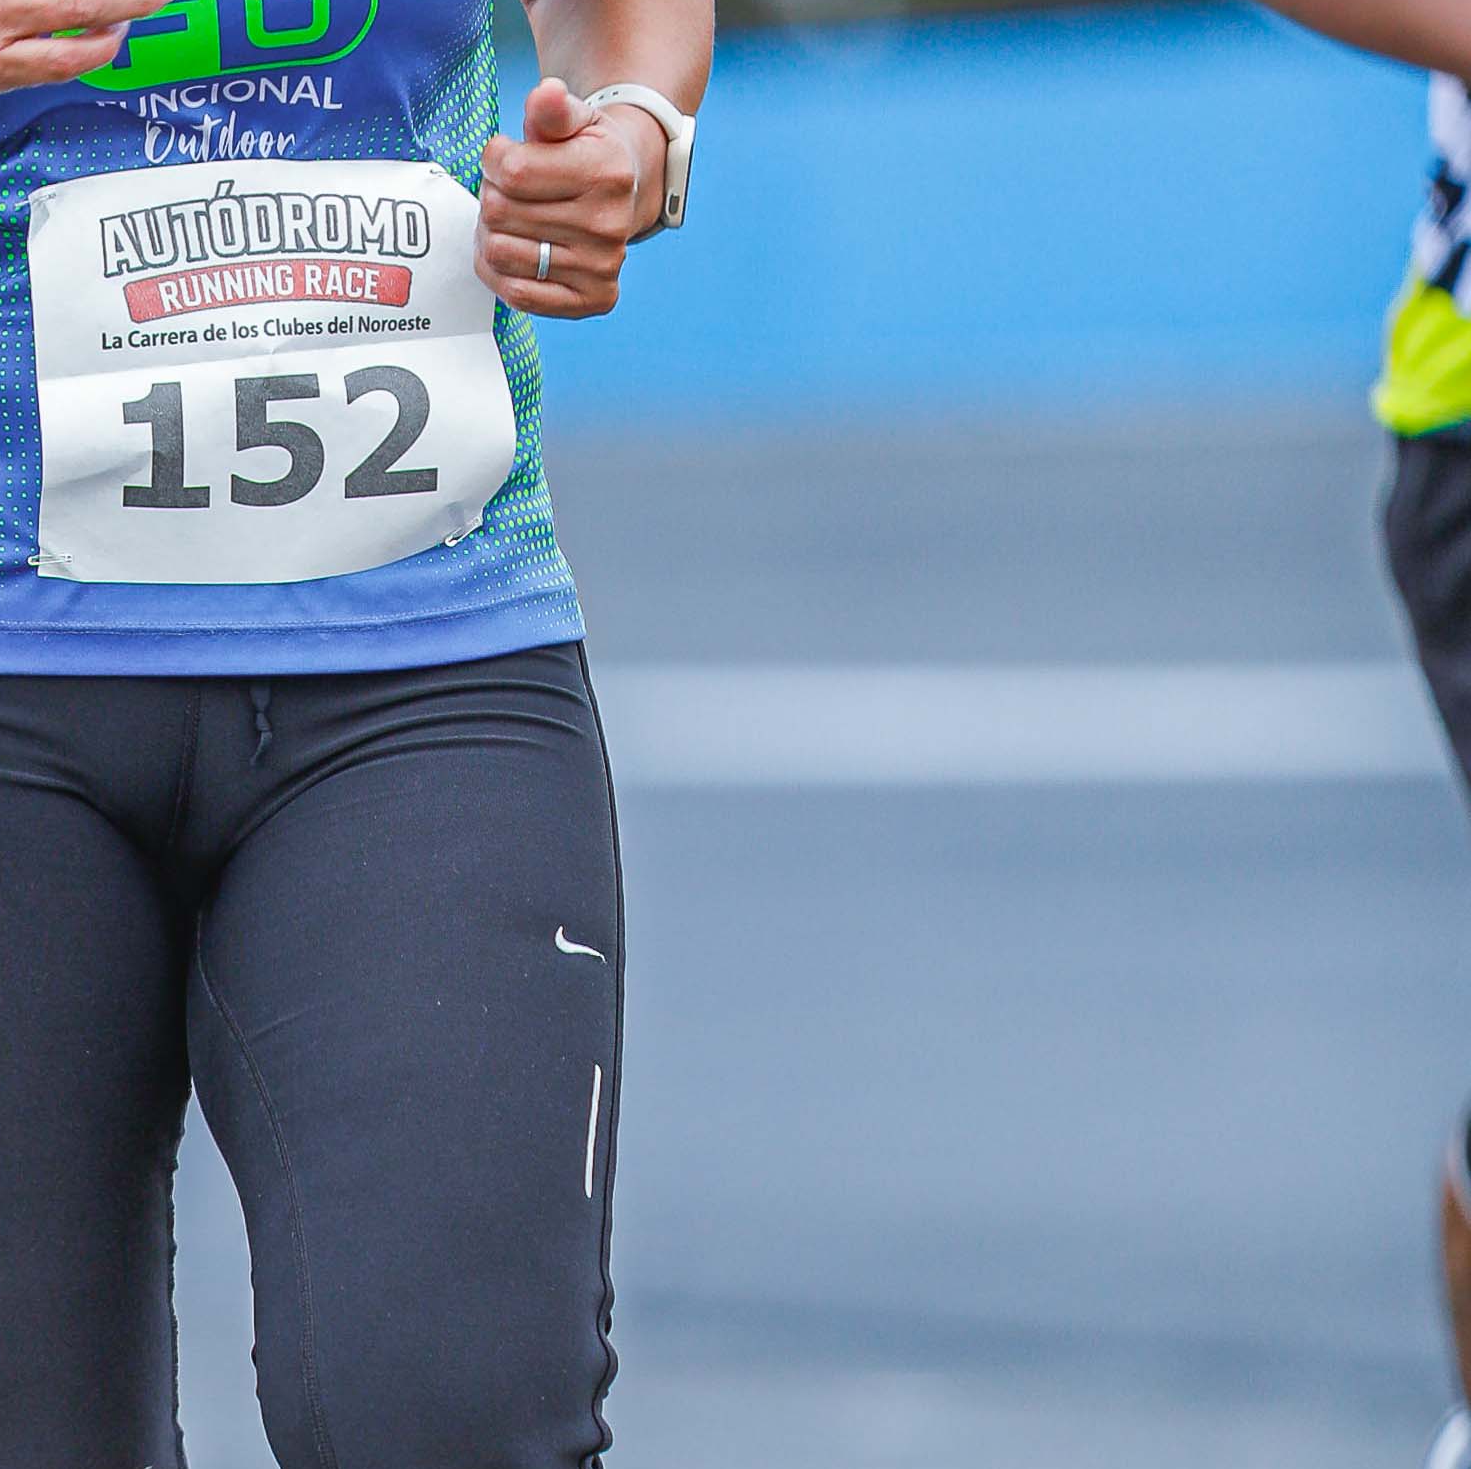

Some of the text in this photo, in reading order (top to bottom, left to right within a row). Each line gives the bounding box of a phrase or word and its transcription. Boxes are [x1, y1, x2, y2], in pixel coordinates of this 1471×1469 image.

[96, 74, 343, 119] NCIONAL
[143, 110, 296, 164] Outdoor
[100, 179, 431, 279] AUTÓDROMO
[158, 263, 380, 314] RUNNING RACE
[101, 314, 431, 350] La Carrera de los Clubes del Noroeste
[122, 365, 439, 509] 152
